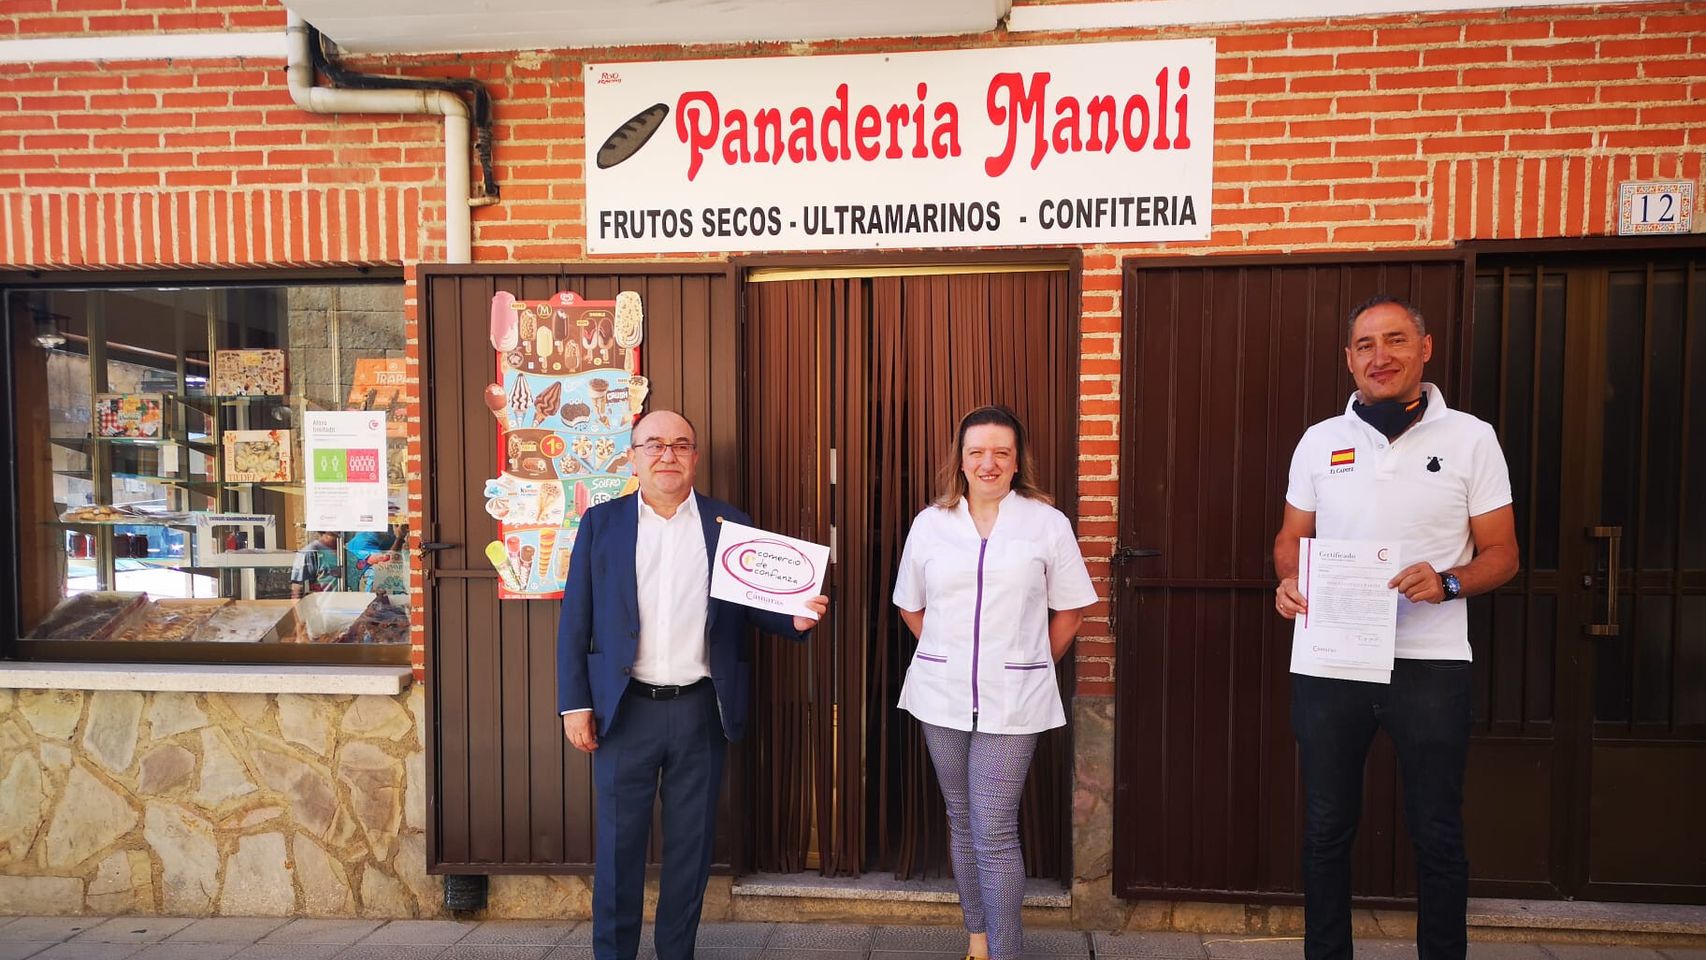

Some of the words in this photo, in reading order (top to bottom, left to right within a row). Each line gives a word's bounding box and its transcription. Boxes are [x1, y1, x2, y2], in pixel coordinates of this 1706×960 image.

[676, 82, 962, 182] Panaderia
[984, 65, 1191, 178] Manoli
[600, 208, 694, 239] FRUTOS
[701, 205, 782, 237] SECOS
[803, 201, 1001, 235] ULTRAMARINOS
[1038, 195, 1197, 230] CONFITERIA
[1641, 193, 1675, 222] 12
[756, 559, 768, 568] de
[757, 551, 801, 566] comercio
[754, 568, 798, 585] confianza
